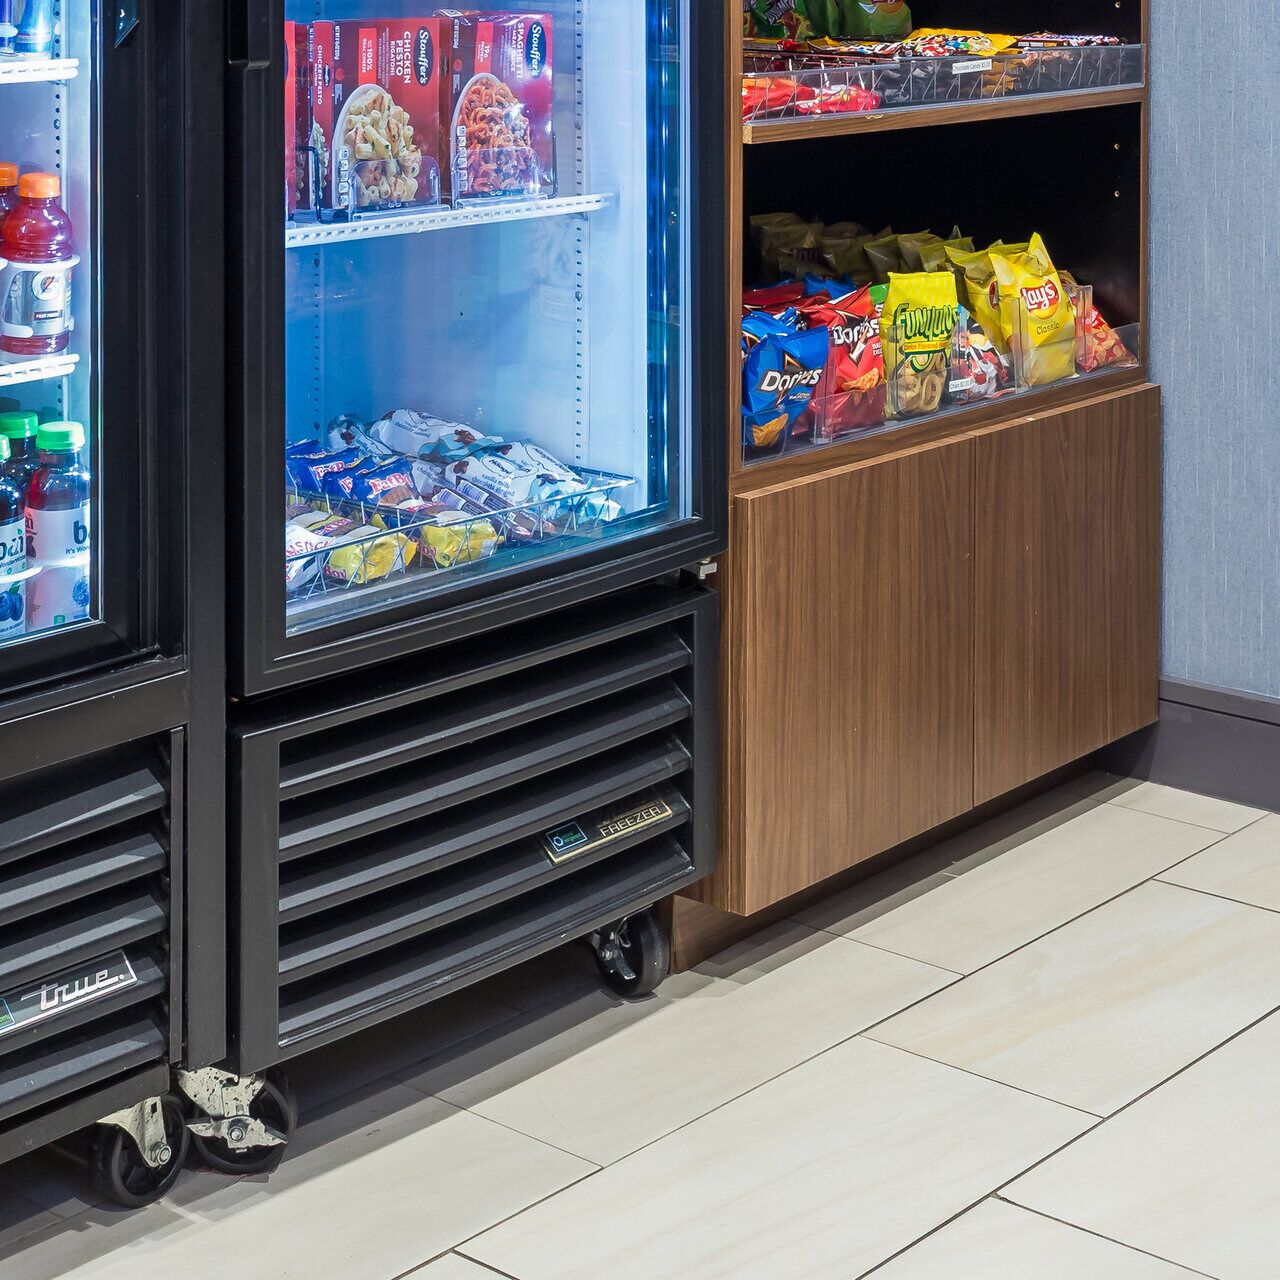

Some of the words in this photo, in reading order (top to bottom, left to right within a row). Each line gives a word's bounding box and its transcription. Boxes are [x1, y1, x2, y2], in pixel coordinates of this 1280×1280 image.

[366, 47, 374, 72] 100%
[396, 39, 404, 77] PESTO
[403, 30, 411, 84] CHICKEN
[418, 29, 428, 84] Stouffer's
[530, 24, 542, 76] Stouffer's
[1023, 283, 1058, 310] Lay's
[1037, 322, 1060, 336] Classic
[760, 369, 822, 392] Doritos
[600, 806, 662, 837] FREEZER
[21, 969, 120, 1010] true
